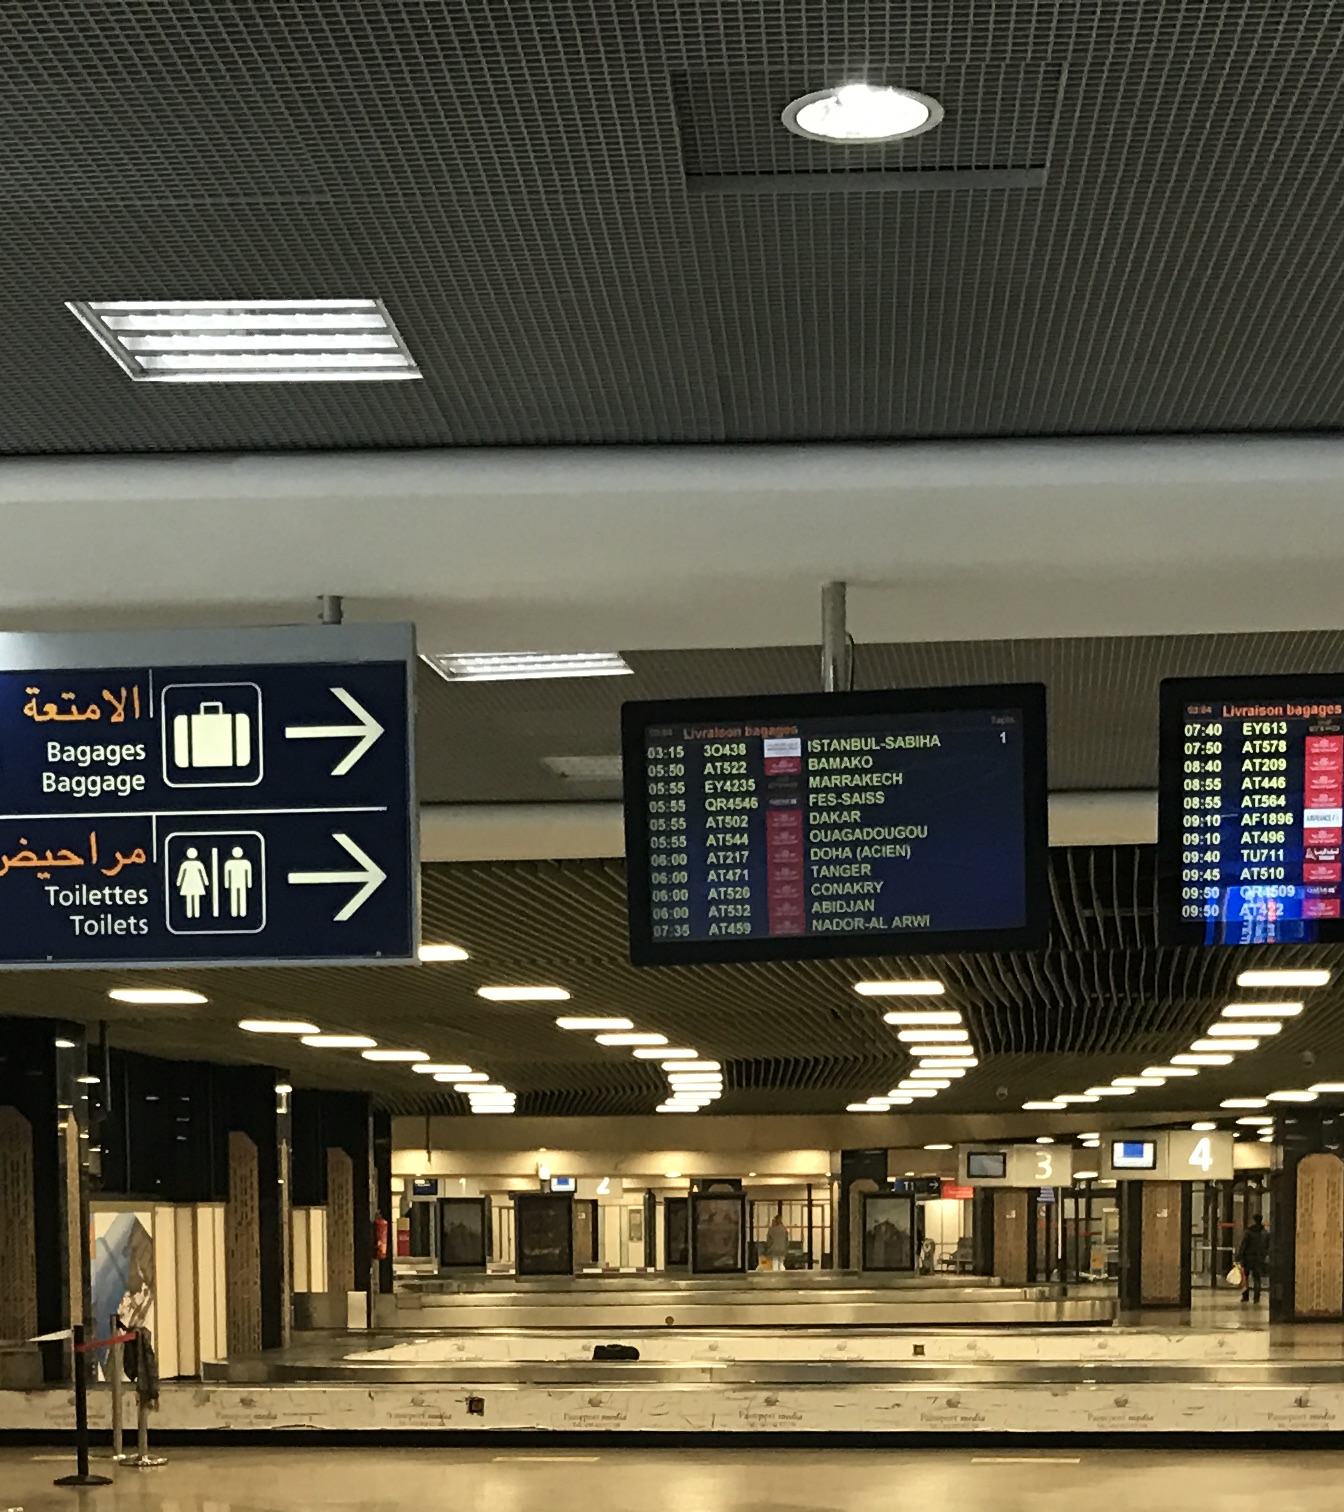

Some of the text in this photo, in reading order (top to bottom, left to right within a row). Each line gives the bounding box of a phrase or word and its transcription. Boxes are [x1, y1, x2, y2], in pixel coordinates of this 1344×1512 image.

[22, 684, 141, 722] الامتعة
[1222, 705, 1283, 717] Livraison
[1287, 704, 1342, 718] bagages
[1184, 723, 1222, 737] 07:40
[1242, 722, 1287, 735] EY613
[648, 746, 684, 759] 03:15
[808, 735, 941, 752] ISTANBUL-SABIHA
[999, 730, 1007, 744] 1
[1184, 742, 1222, 755] 07:50
[1242, 740, 1287, 754] AT578
[46, 740, 146, 768] Bagages
[648, 755, 873, 776] 05:50 AT522 BAMAKO
[1184, 760, 1222, 773] 08:40
[1242, 758, 1287, 772] AT209
[41, 770, 146, 797] Baggage
[649, 782, 685, 795] 05:55
[705, 779, 756, 793] EY4235
[808, 772, 903, 788] MARRAKECH
[1183, 778, 1222, 791] 08:55
[1241, 777, 1286, 790] AT446
[649, 800, 685, 812] 05:55
[809, 791, 885, 806] FES-SAISS
[1183, 796, 1222, 810] 08:55
[1241, 795, 1286, 808] AT564
[649, 810, 861, 830] 05:55 AT502 DAKAR
[1183, 814, 1221, 828] 09:10
[1241, 812, 1294, 826] AF1896
[650, 825, 928, 848] 05:55 AT544 OUAGADOUGOU
[1183, 832, 1221, 845] 09:10
[1240, 831, 1285, 844] AT496
[707, 851, 749, 864] AT217
[810, 847, 852, 860] DOHA
[856, 845, 911, 861] (ACIEN)
[1182, 850, 1221, 863] 09:40
[1241, 849, 1284, 862] TU711
[707, 869, 749, 882] AT471
[811, 864, 871, 877] TANGER
[1182, 868, 1220, 882] 09:45
[1240, 867, 1285, 880] AT510
[45, 884, 149, 907] Toilettes
[811, 881, 884, 895] CONAKRY
[1182, 886, 1220, 900] 09:50
[709, 905, 751, 918] AT532
[812, 899, 875, 913] ABIDJAN
[1182, 904, 1219, 917] 09:50
[69, 913, 149, 936] Toilets
[653, 914, 930, 937] 07:35 AT459 NADOR-AL ARWI
[1188, 1138, 1213, 1171] 4
[1035, 1152, 1052, 1179] 3
[458, 1177, 467, 1194] 1
[596, 1177, 611, 1195] 2
